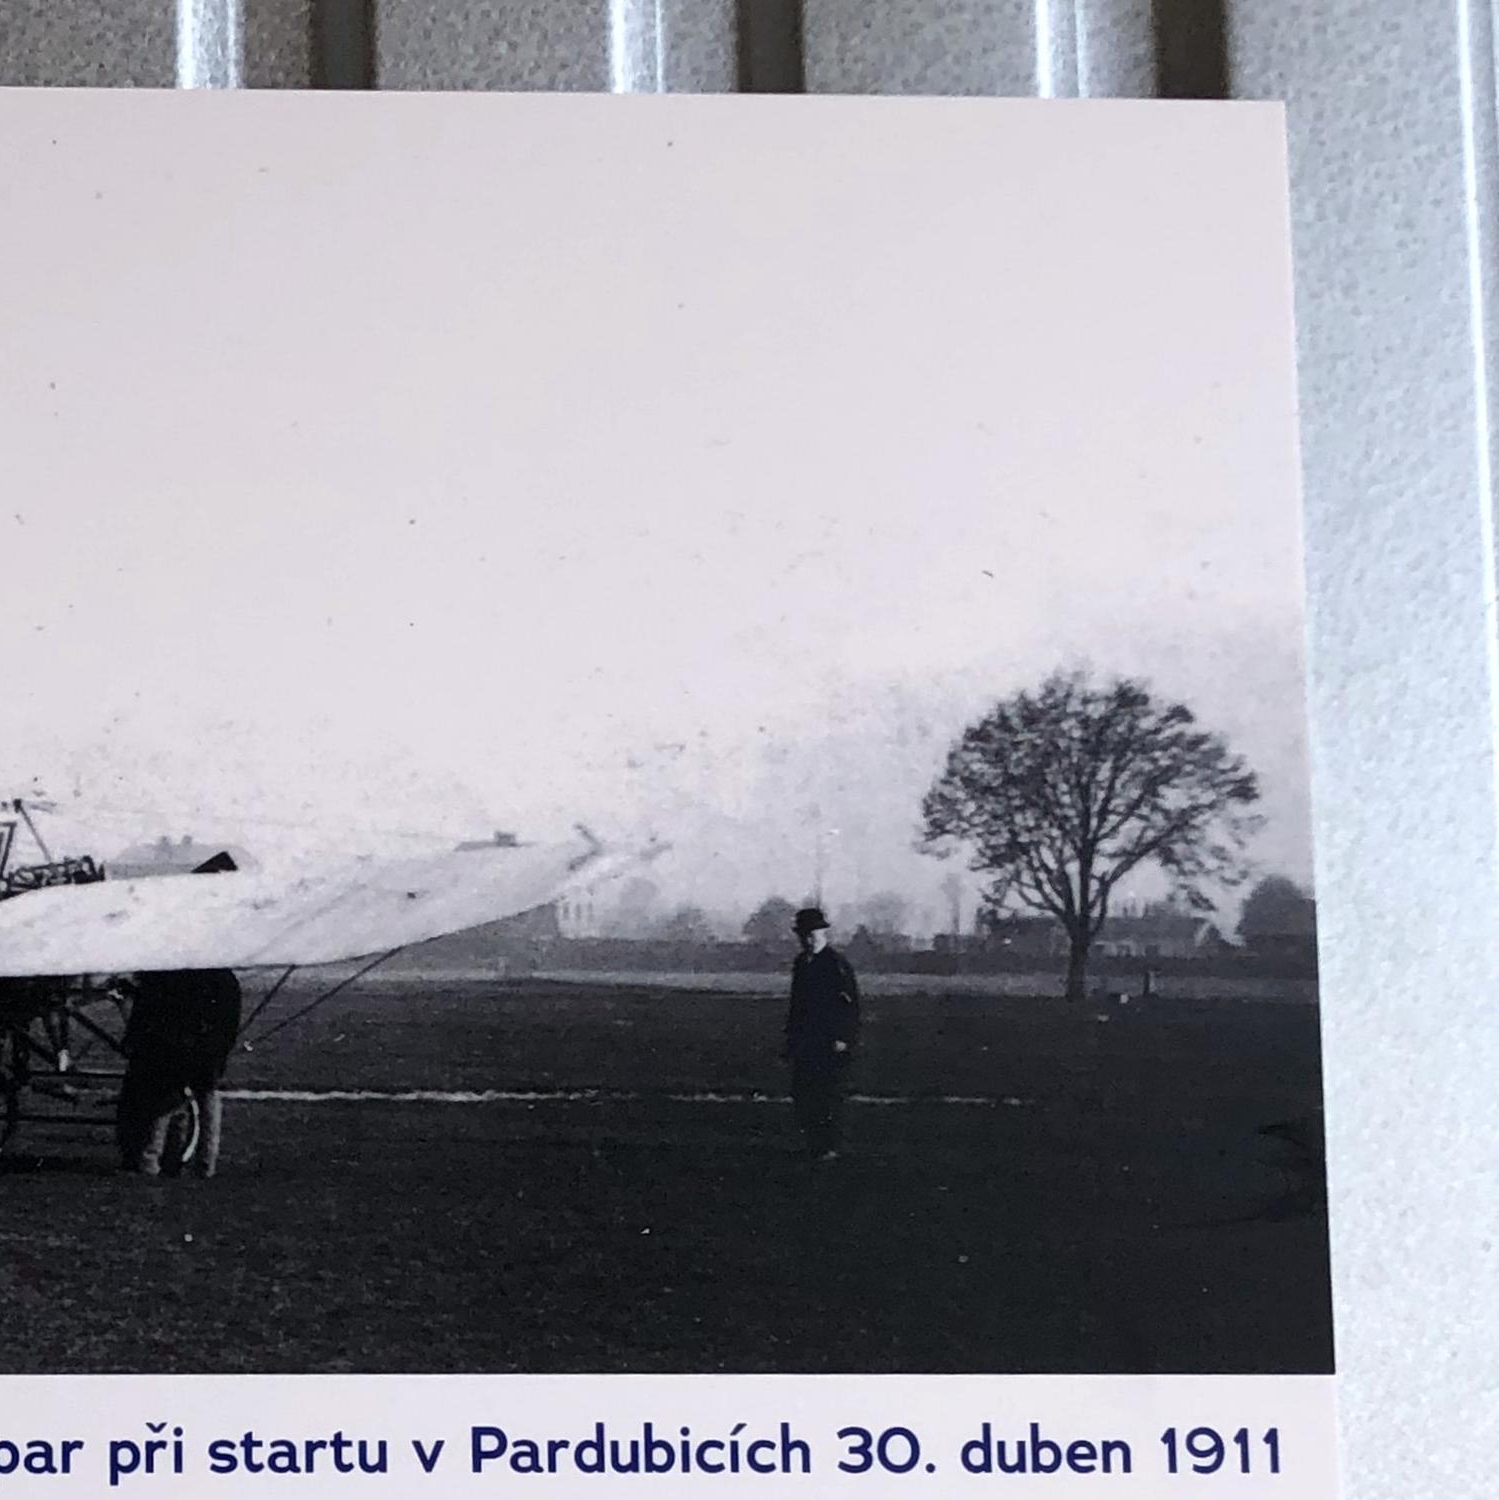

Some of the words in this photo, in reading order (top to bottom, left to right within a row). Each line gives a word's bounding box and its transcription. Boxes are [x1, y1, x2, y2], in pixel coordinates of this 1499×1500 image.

[109, 1423, 184, 1487] při
[208, 1430, 388, 1475] startu
[411, 1439, 445, 1473] v
[471, 1422, 811, 1475] Pardubicích
[836, 1426, 936, 1474] 30.
[960, 1423, 1132, 1474] duben
[1160, 1426, 1280, 1475] 1911
